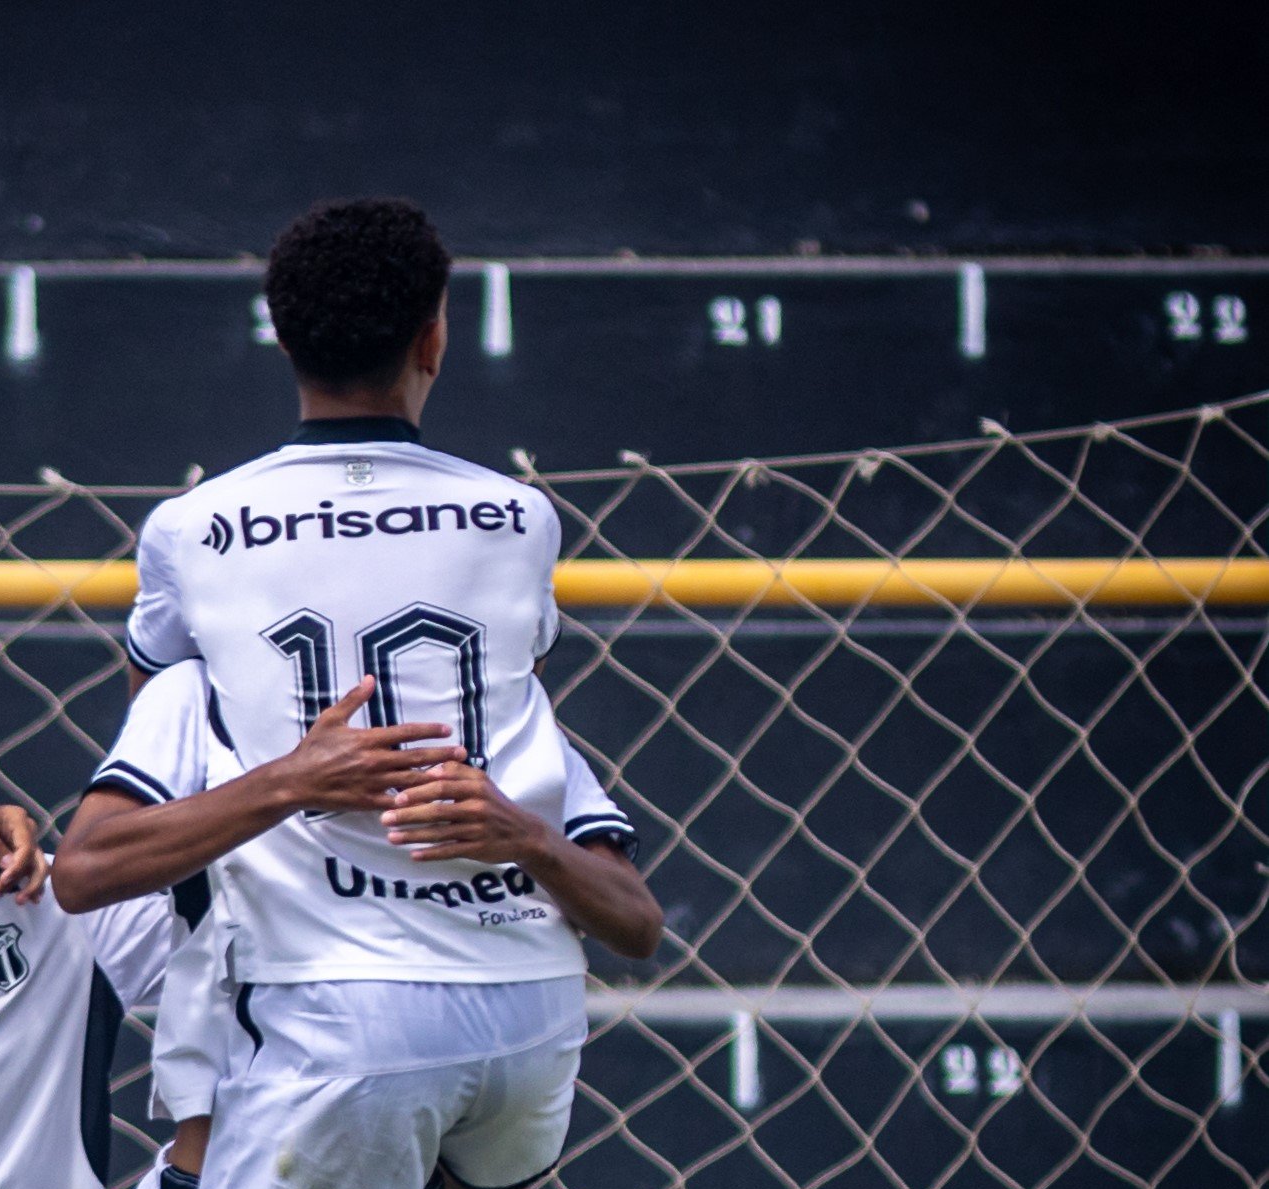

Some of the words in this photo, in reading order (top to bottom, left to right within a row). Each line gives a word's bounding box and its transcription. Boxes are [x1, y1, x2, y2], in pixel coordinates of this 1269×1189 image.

[708, 295, 782, 347] 21
[1164, 291, 1247, 344] 22
[241, 499, 526, 548] brisanet
[259, 600, 492, 822] 10
[942, 1044, 1023, 1095] 22
